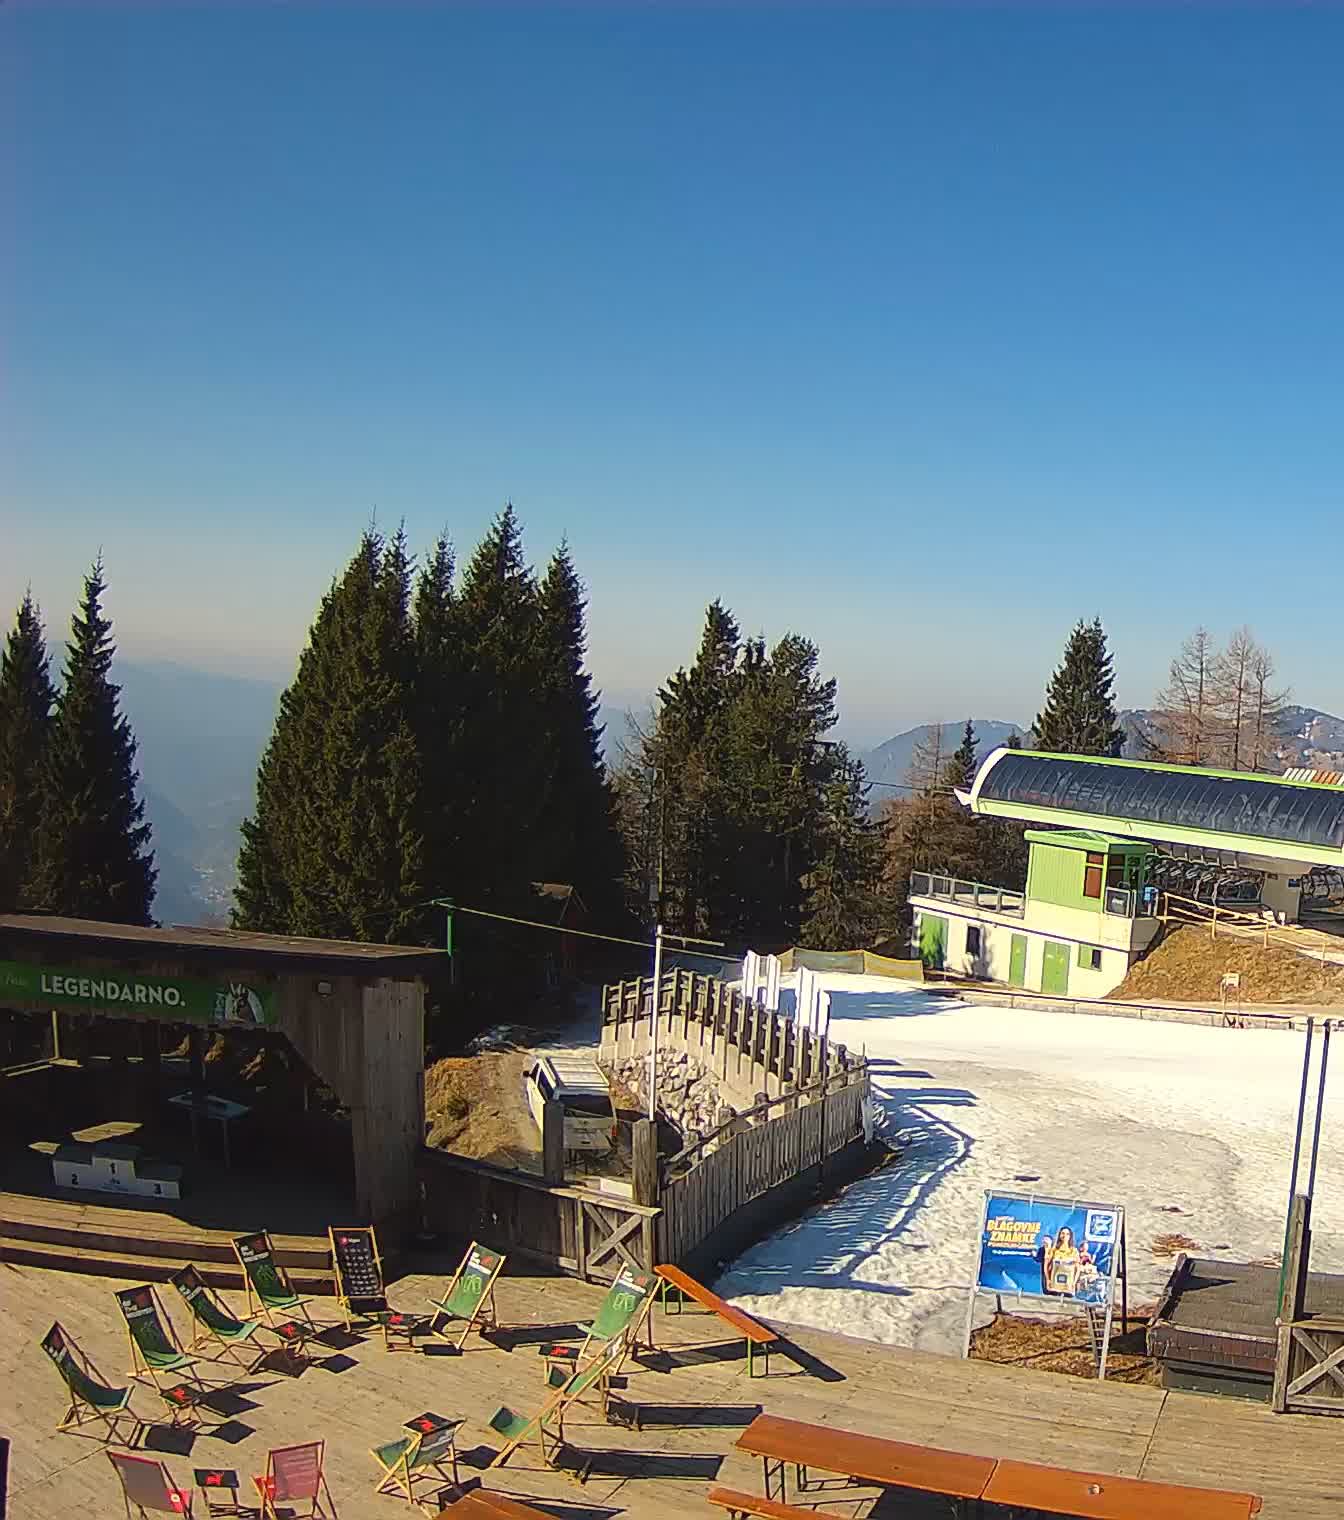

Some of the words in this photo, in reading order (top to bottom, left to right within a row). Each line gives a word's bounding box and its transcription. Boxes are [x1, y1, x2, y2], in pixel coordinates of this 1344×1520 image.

[41, 974, 186, 1006] LEGENDARNO.
[109, 1162, 116, 1175] 1
[71, 1173, 79, 1185] 2
